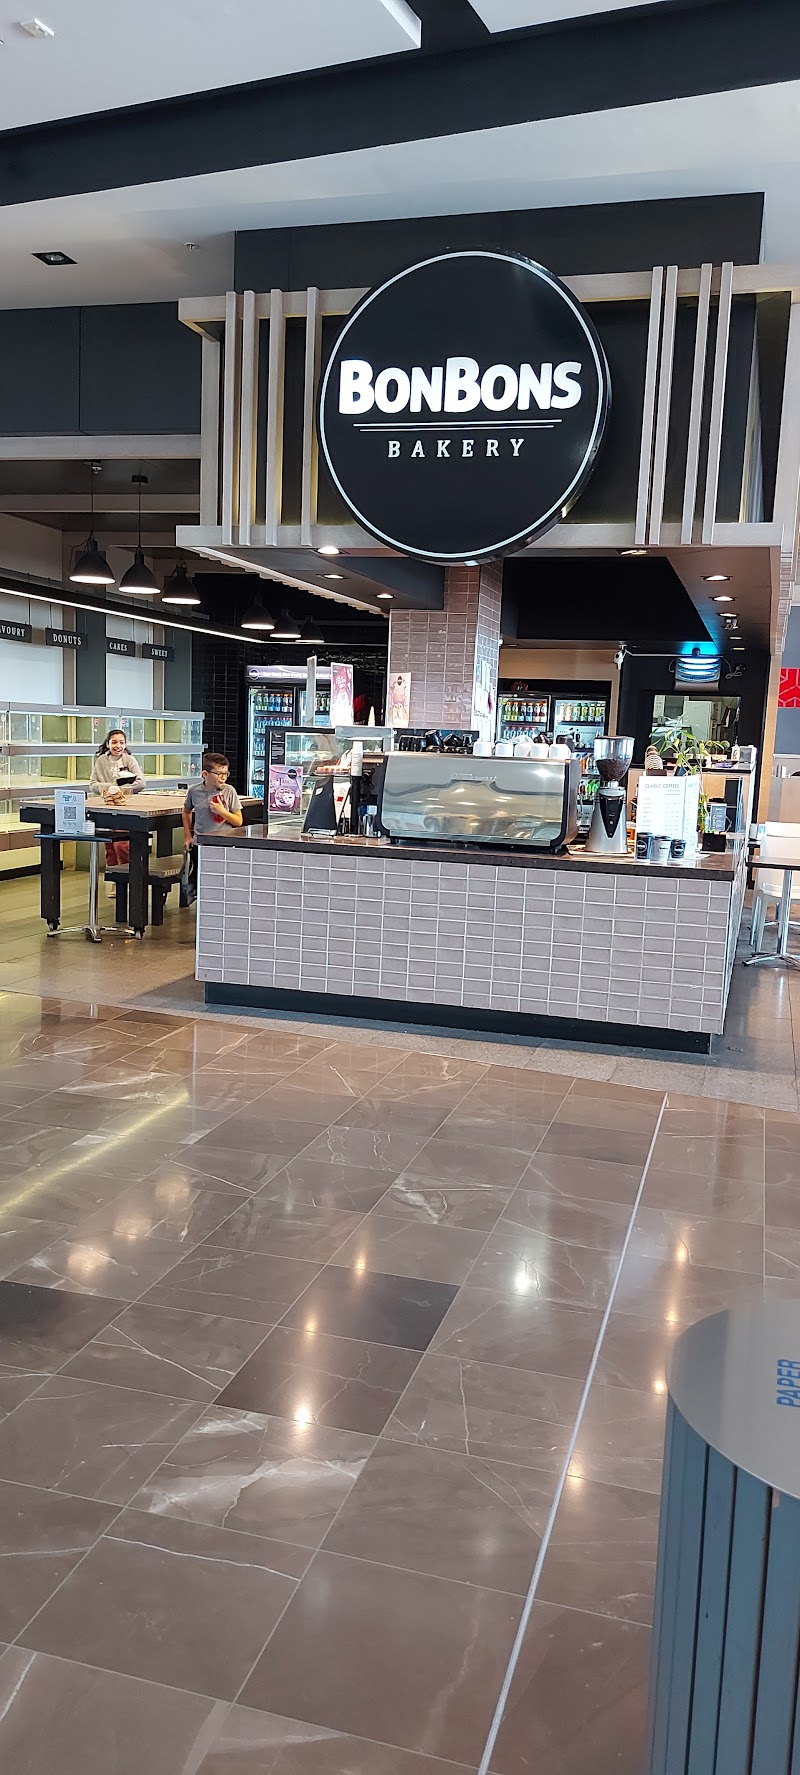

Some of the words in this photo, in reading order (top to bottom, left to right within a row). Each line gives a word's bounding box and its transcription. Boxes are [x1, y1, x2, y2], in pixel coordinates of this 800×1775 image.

[387, 438, 525, 459] BAKERY
[0, 625, 26, 637] VOURY
[52, 633, 82, 646] DONUTS
[109, 641, 128, 652] CAKES
[150, 647, 168, 658] SWEET
[776, 1359, 800, 1408] PAPER
